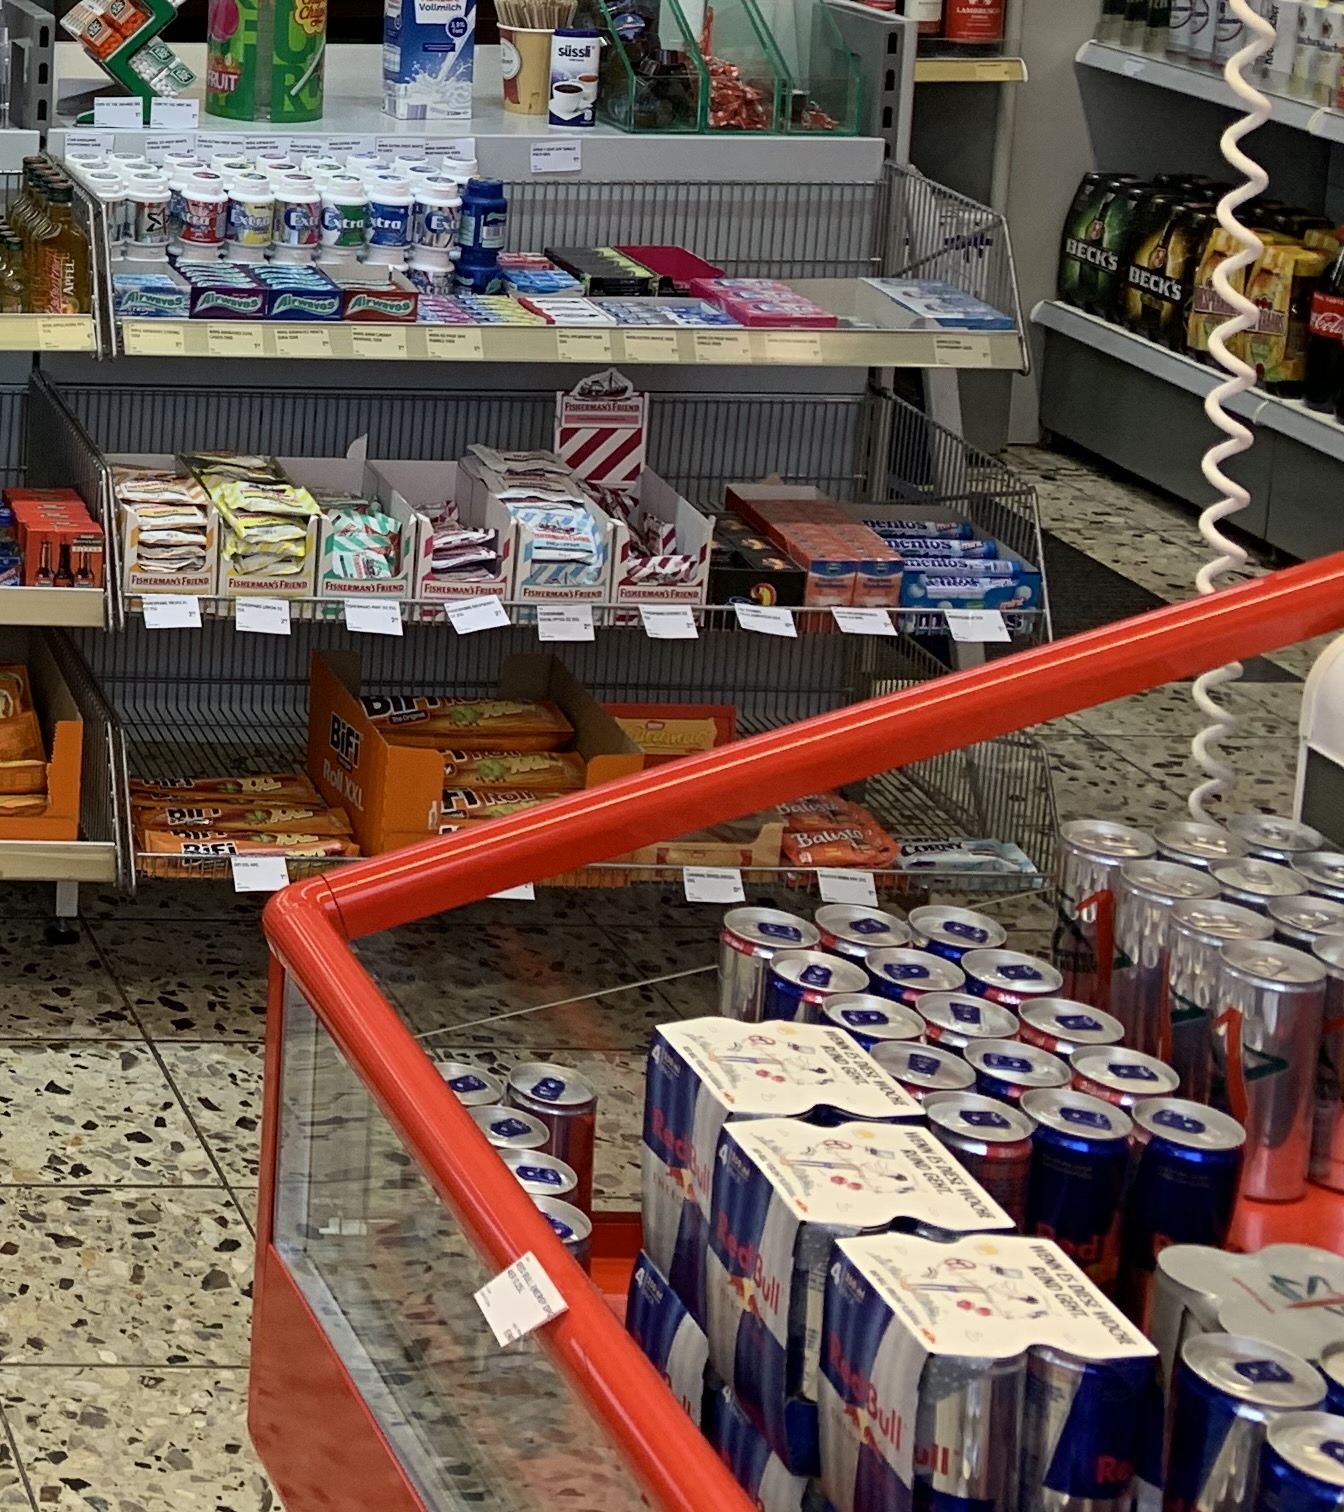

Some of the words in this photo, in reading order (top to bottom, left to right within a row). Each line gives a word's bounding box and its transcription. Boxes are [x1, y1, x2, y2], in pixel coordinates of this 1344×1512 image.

[418, 2, 462, 13] Vollmilch
[558, 44, 591, 58] süssli
[277, 295, 337, 310] Airwaves
[613, 402, 640, 413] FRIEND
[330, 714, 360, 759] BiFi
[790, 826, 864, 848] Balisto
[1028, 1267, 1063, 1291] RUND
[1068, 1285, 1103, 1309] DIESE
[1093, 1312, 1138, 1345] WOCHE
[828, 1333, 867, 1394] Red
[867, 1381, 902, 1451] Bull
